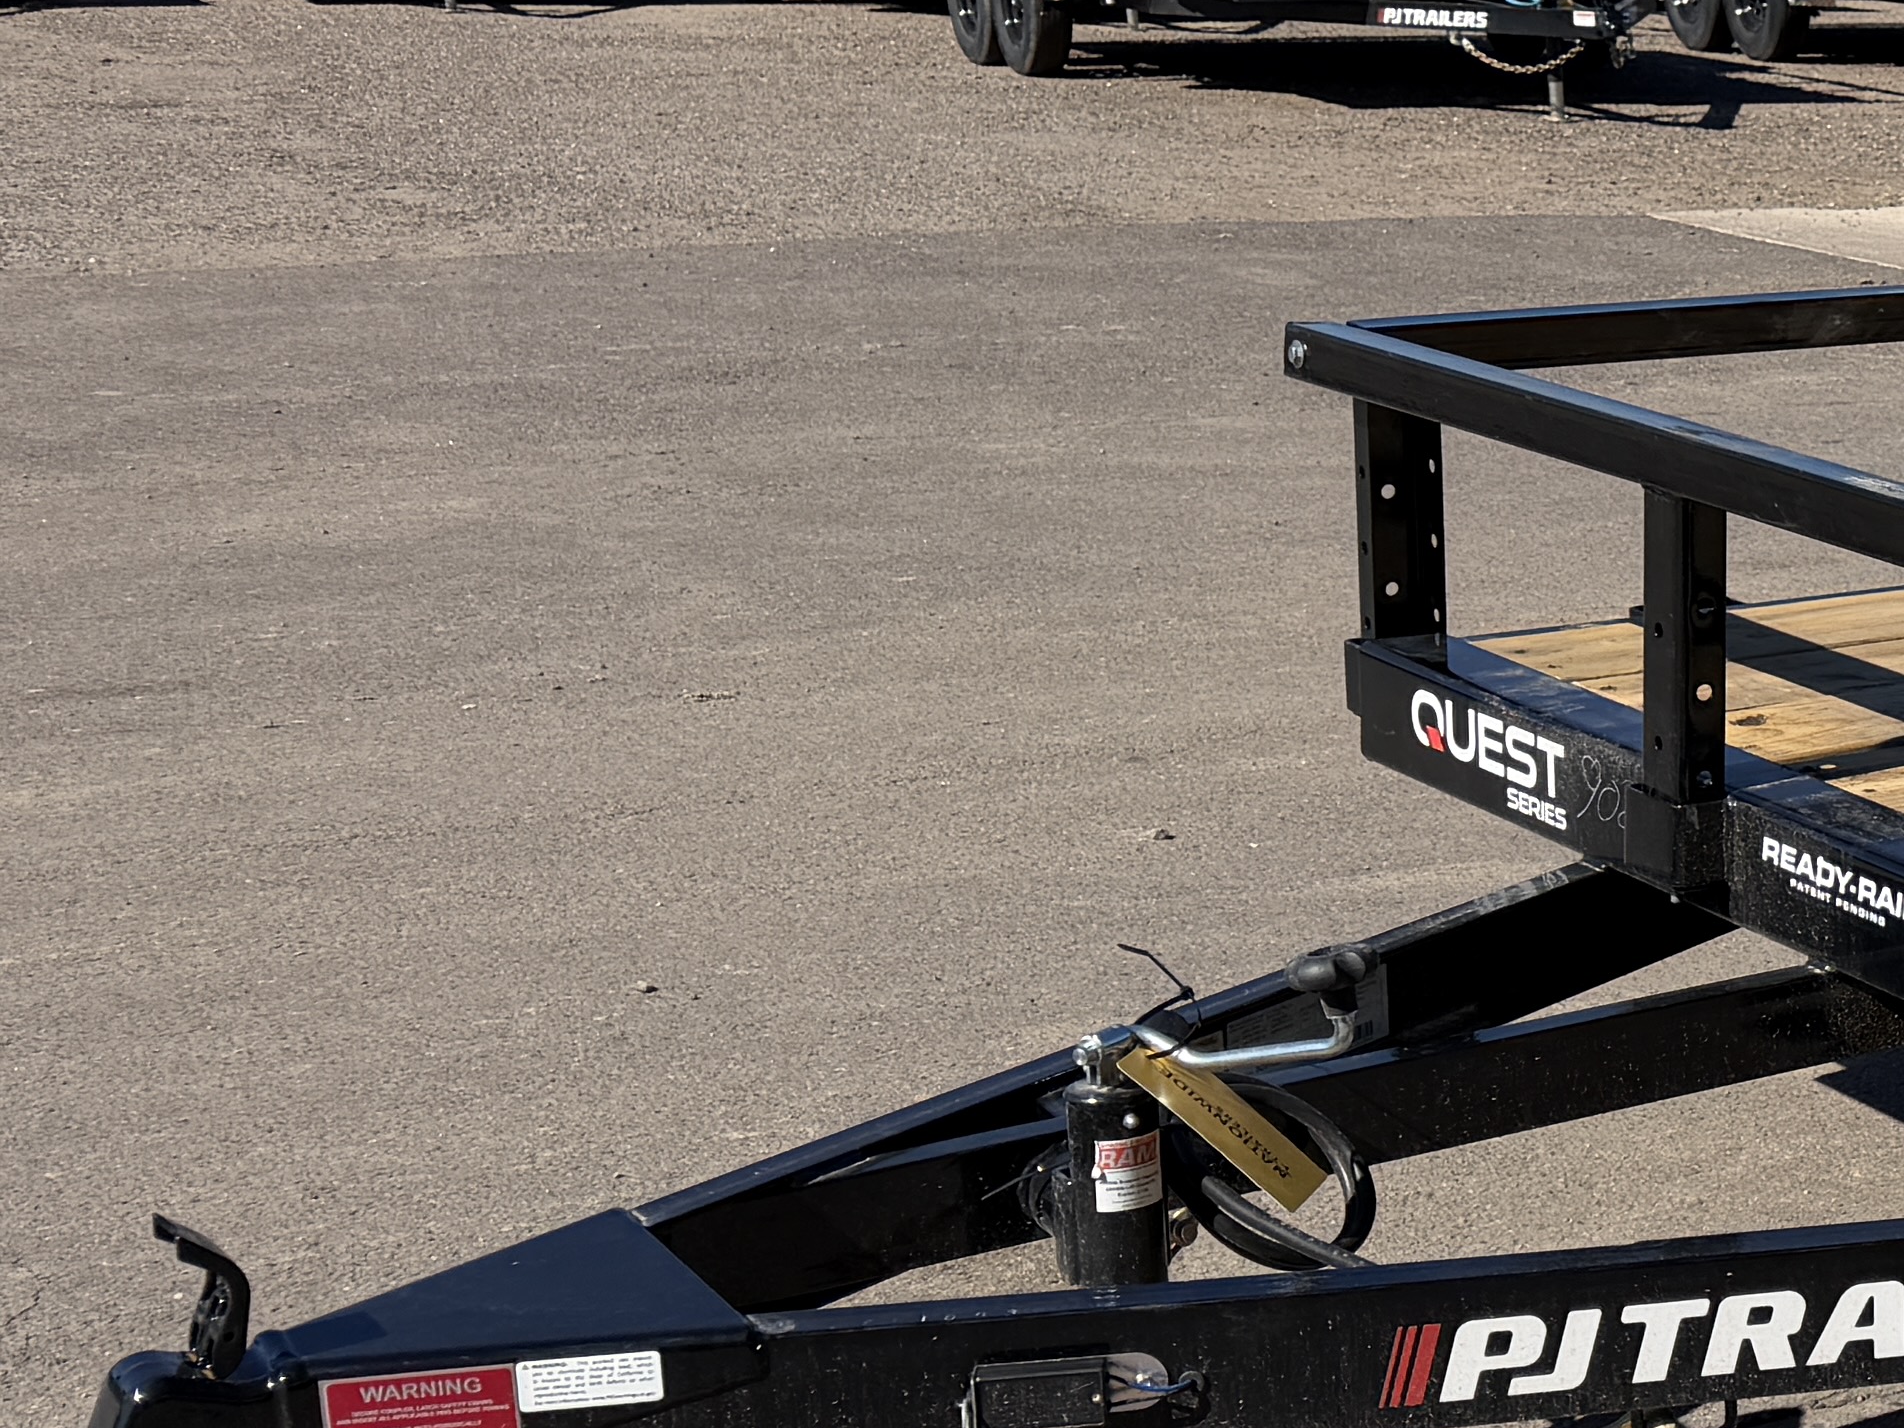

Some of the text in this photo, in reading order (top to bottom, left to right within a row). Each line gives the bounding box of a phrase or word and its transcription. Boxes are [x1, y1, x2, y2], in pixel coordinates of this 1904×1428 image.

[1411, 688, 1565, 799] QUEST
[1506, 788, 1568, 831] SERIES
[1789, 877, 1886, 928] PATENT PENDING
[1157, 1067, 1291, 1179] NATIONWIDE
[359, 1377, 482, 1403] WARNING
